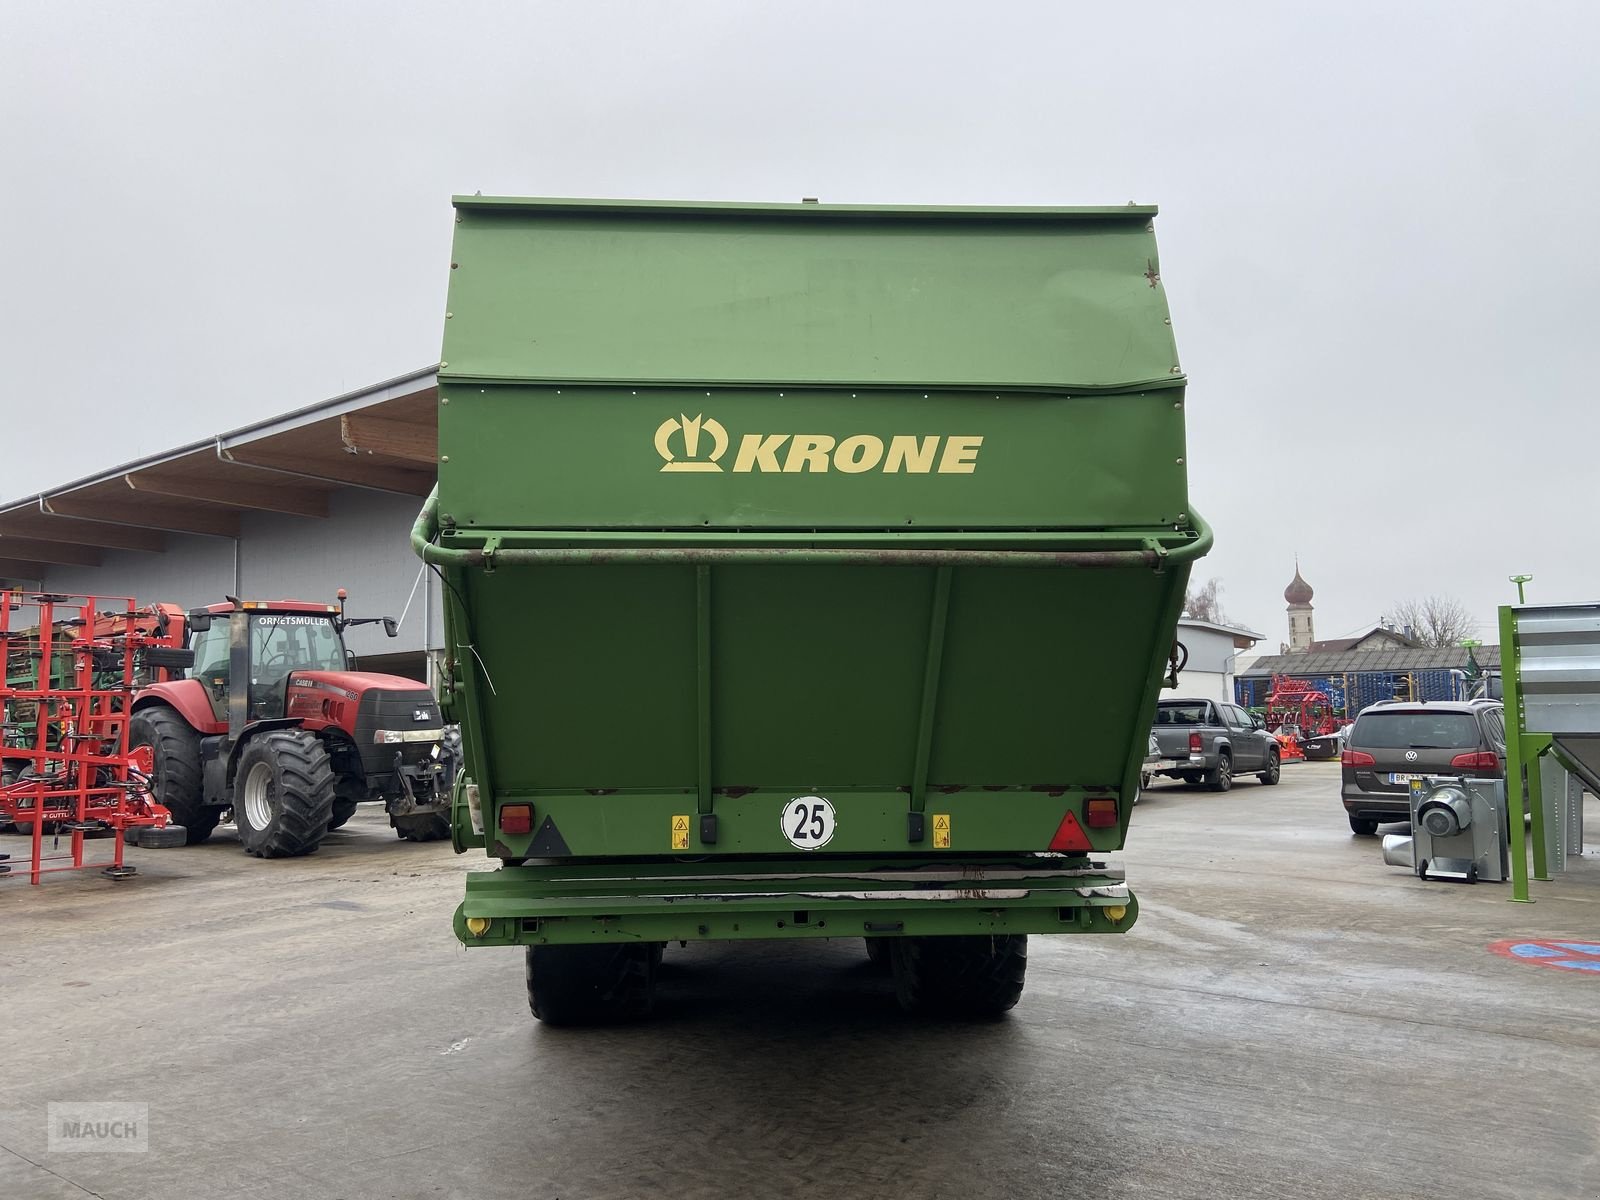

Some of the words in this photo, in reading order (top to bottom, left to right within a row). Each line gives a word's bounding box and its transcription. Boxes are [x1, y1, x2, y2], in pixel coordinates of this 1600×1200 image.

[732, 434, 985, 474] KRONE
[259, 616, 329, 626] ORNETSMÜLLER
[793, 803, 825, 840] 25
